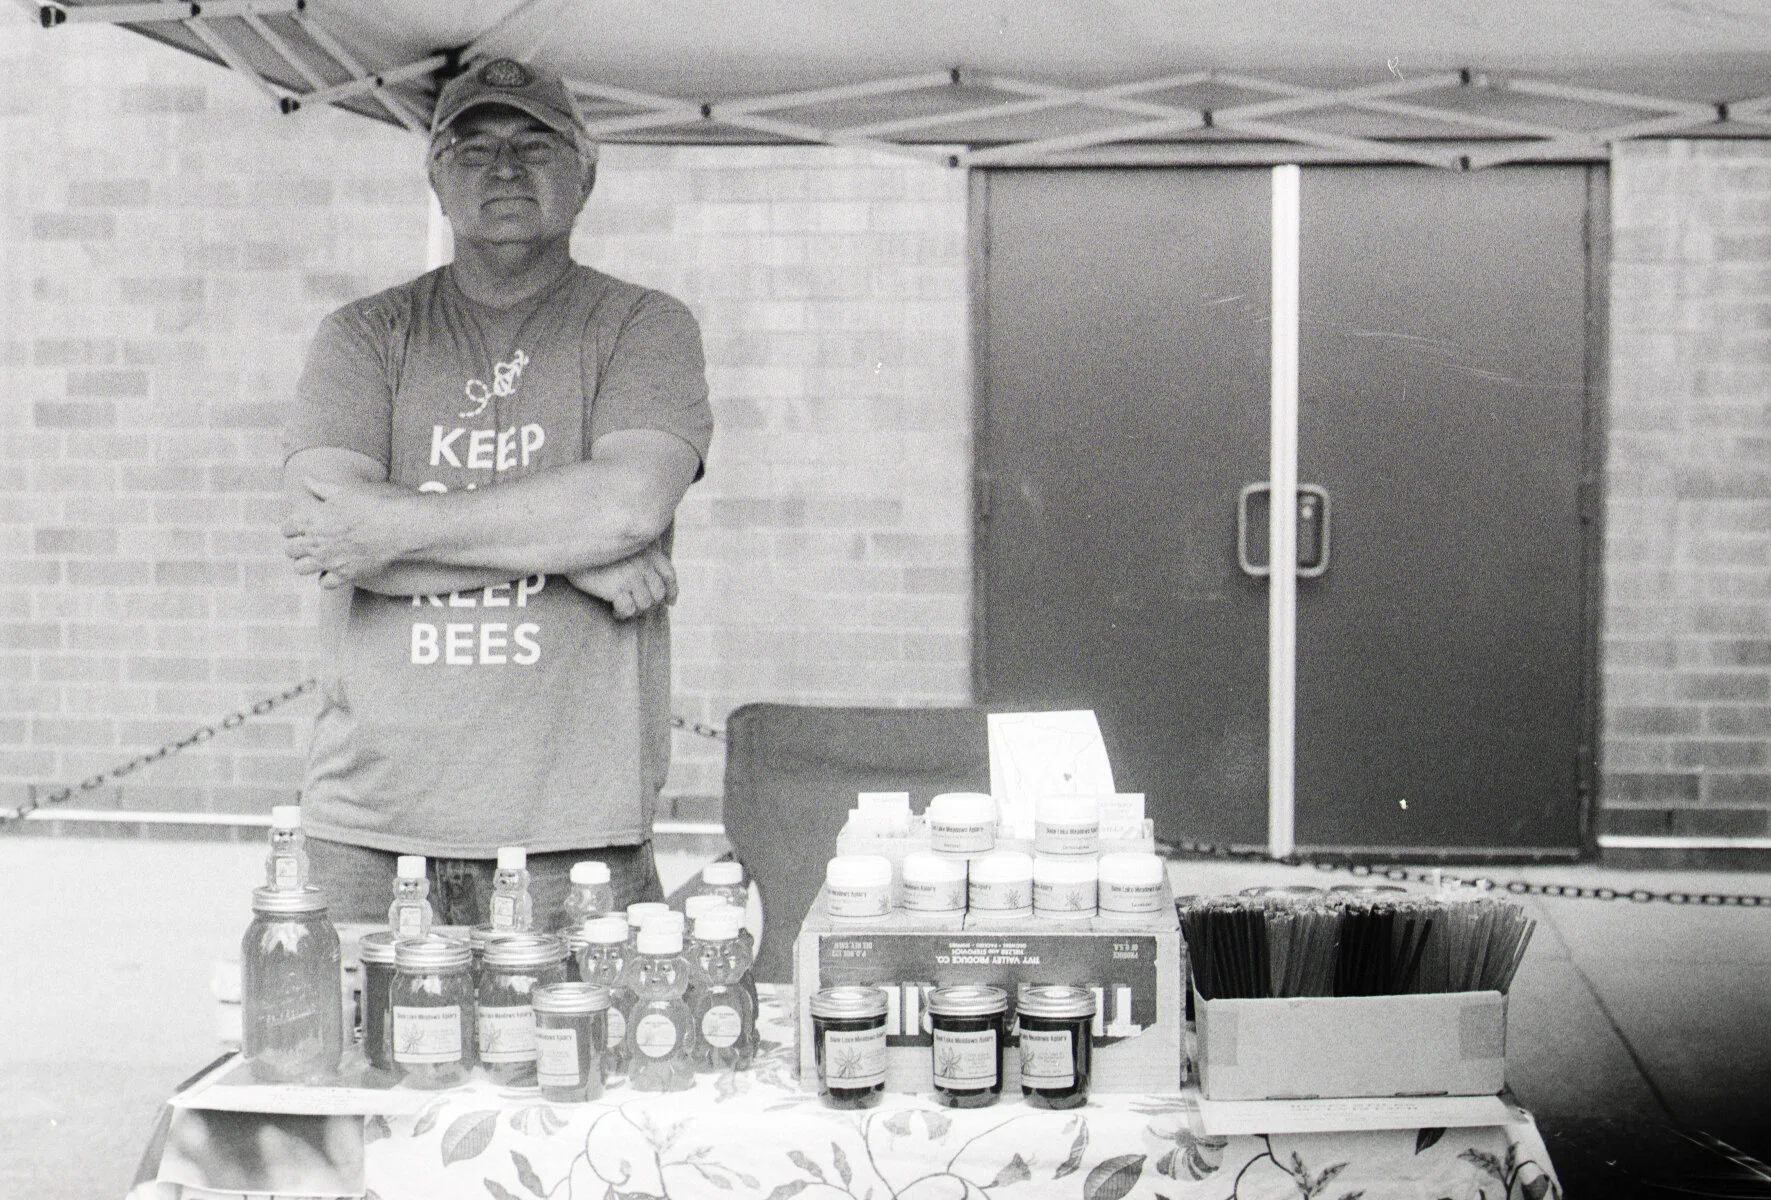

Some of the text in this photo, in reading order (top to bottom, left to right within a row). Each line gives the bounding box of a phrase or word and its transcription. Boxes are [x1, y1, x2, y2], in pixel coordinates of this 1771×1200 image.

[429, 423, 546, 471] KEEP
[411, 573, 546, 608] EP
[410, 622, 541, 665] BEES
[1113, 951, 1139, 959] PRODUCE
[1131, 943, 1139, 951] OF
[935, 955, 1040, 964] TIVY VALLEY PRODUCE CO.
